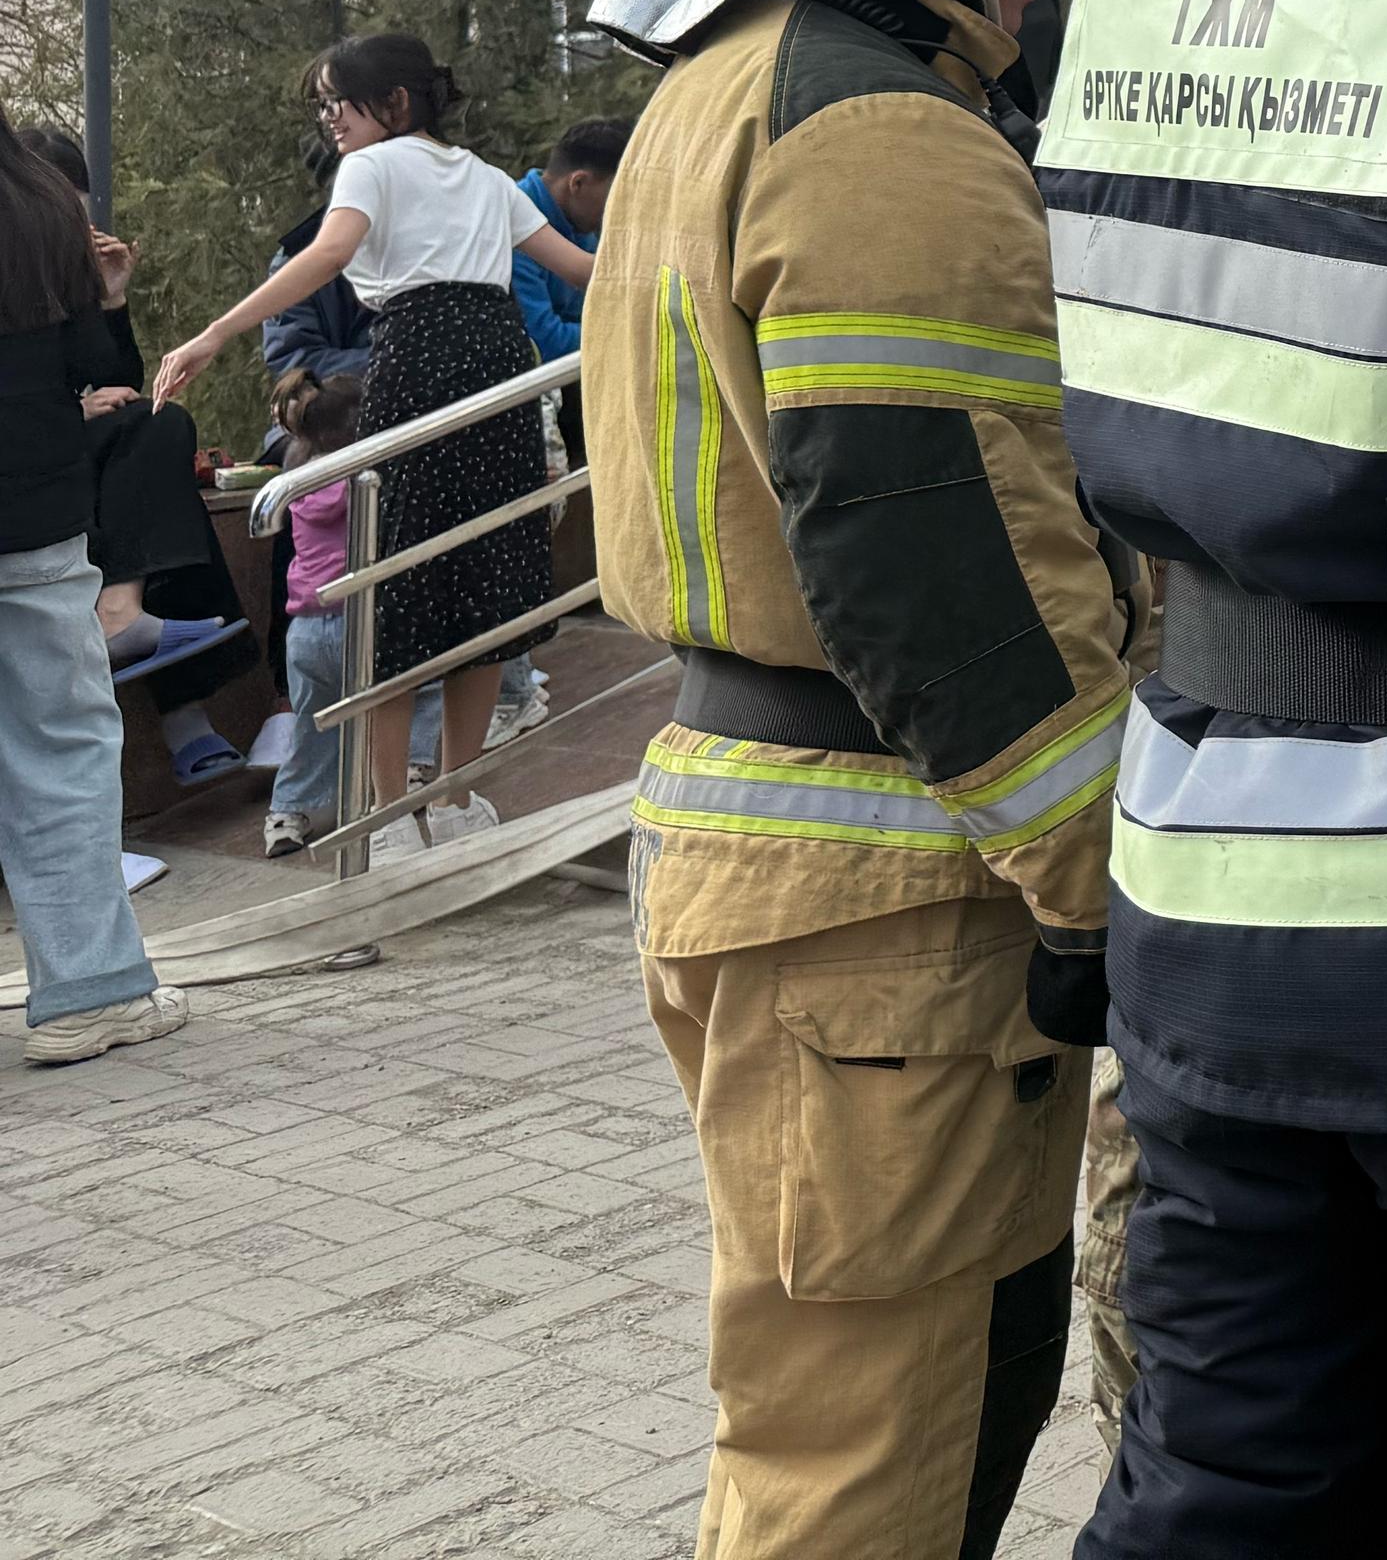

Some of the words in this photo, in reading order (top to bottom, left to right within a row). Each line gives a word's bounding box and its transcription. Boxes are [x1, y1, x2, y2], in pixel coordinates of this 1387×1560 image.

[1083, 69, 1142, 122] ӨРТКЕ
[1145, 71, 1235, 137] ҚАРСЫ
[1238, 76, 1384, 144] ҚЫЗМЕТІ
